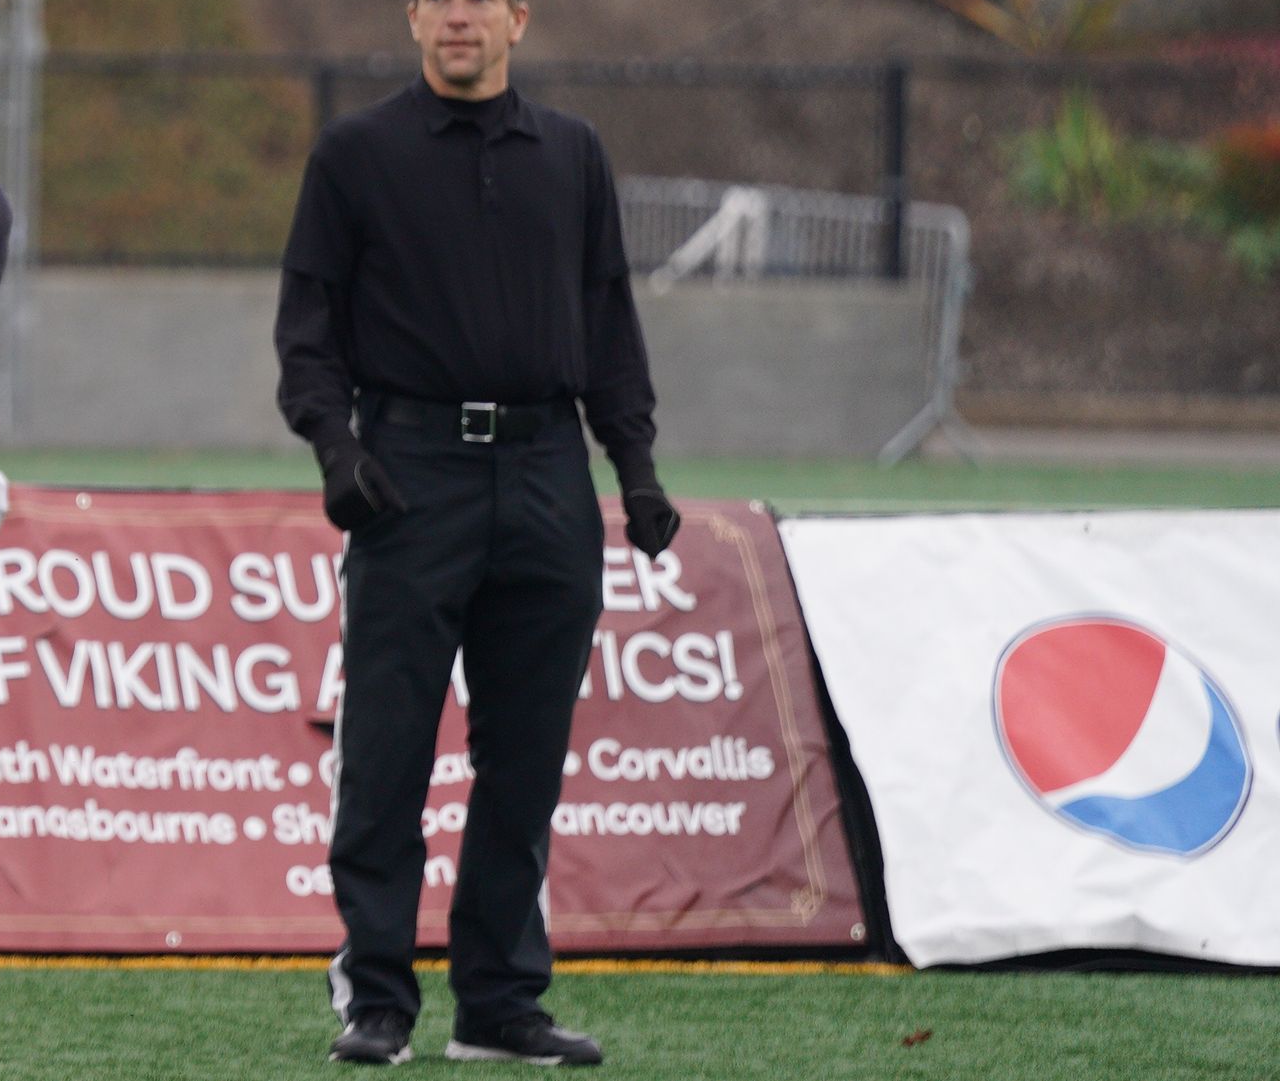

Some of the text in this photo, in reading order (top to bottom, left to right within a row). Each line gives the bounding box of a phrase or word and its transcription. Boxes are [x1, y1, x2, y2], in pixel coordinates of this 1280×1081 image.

[35, 638, 300, 713] VIKING
[49, 743, 285, 792] Waterfront
[587, 734, 775, 782] Corvallis
[550, 801, 747, 837] ancouver
